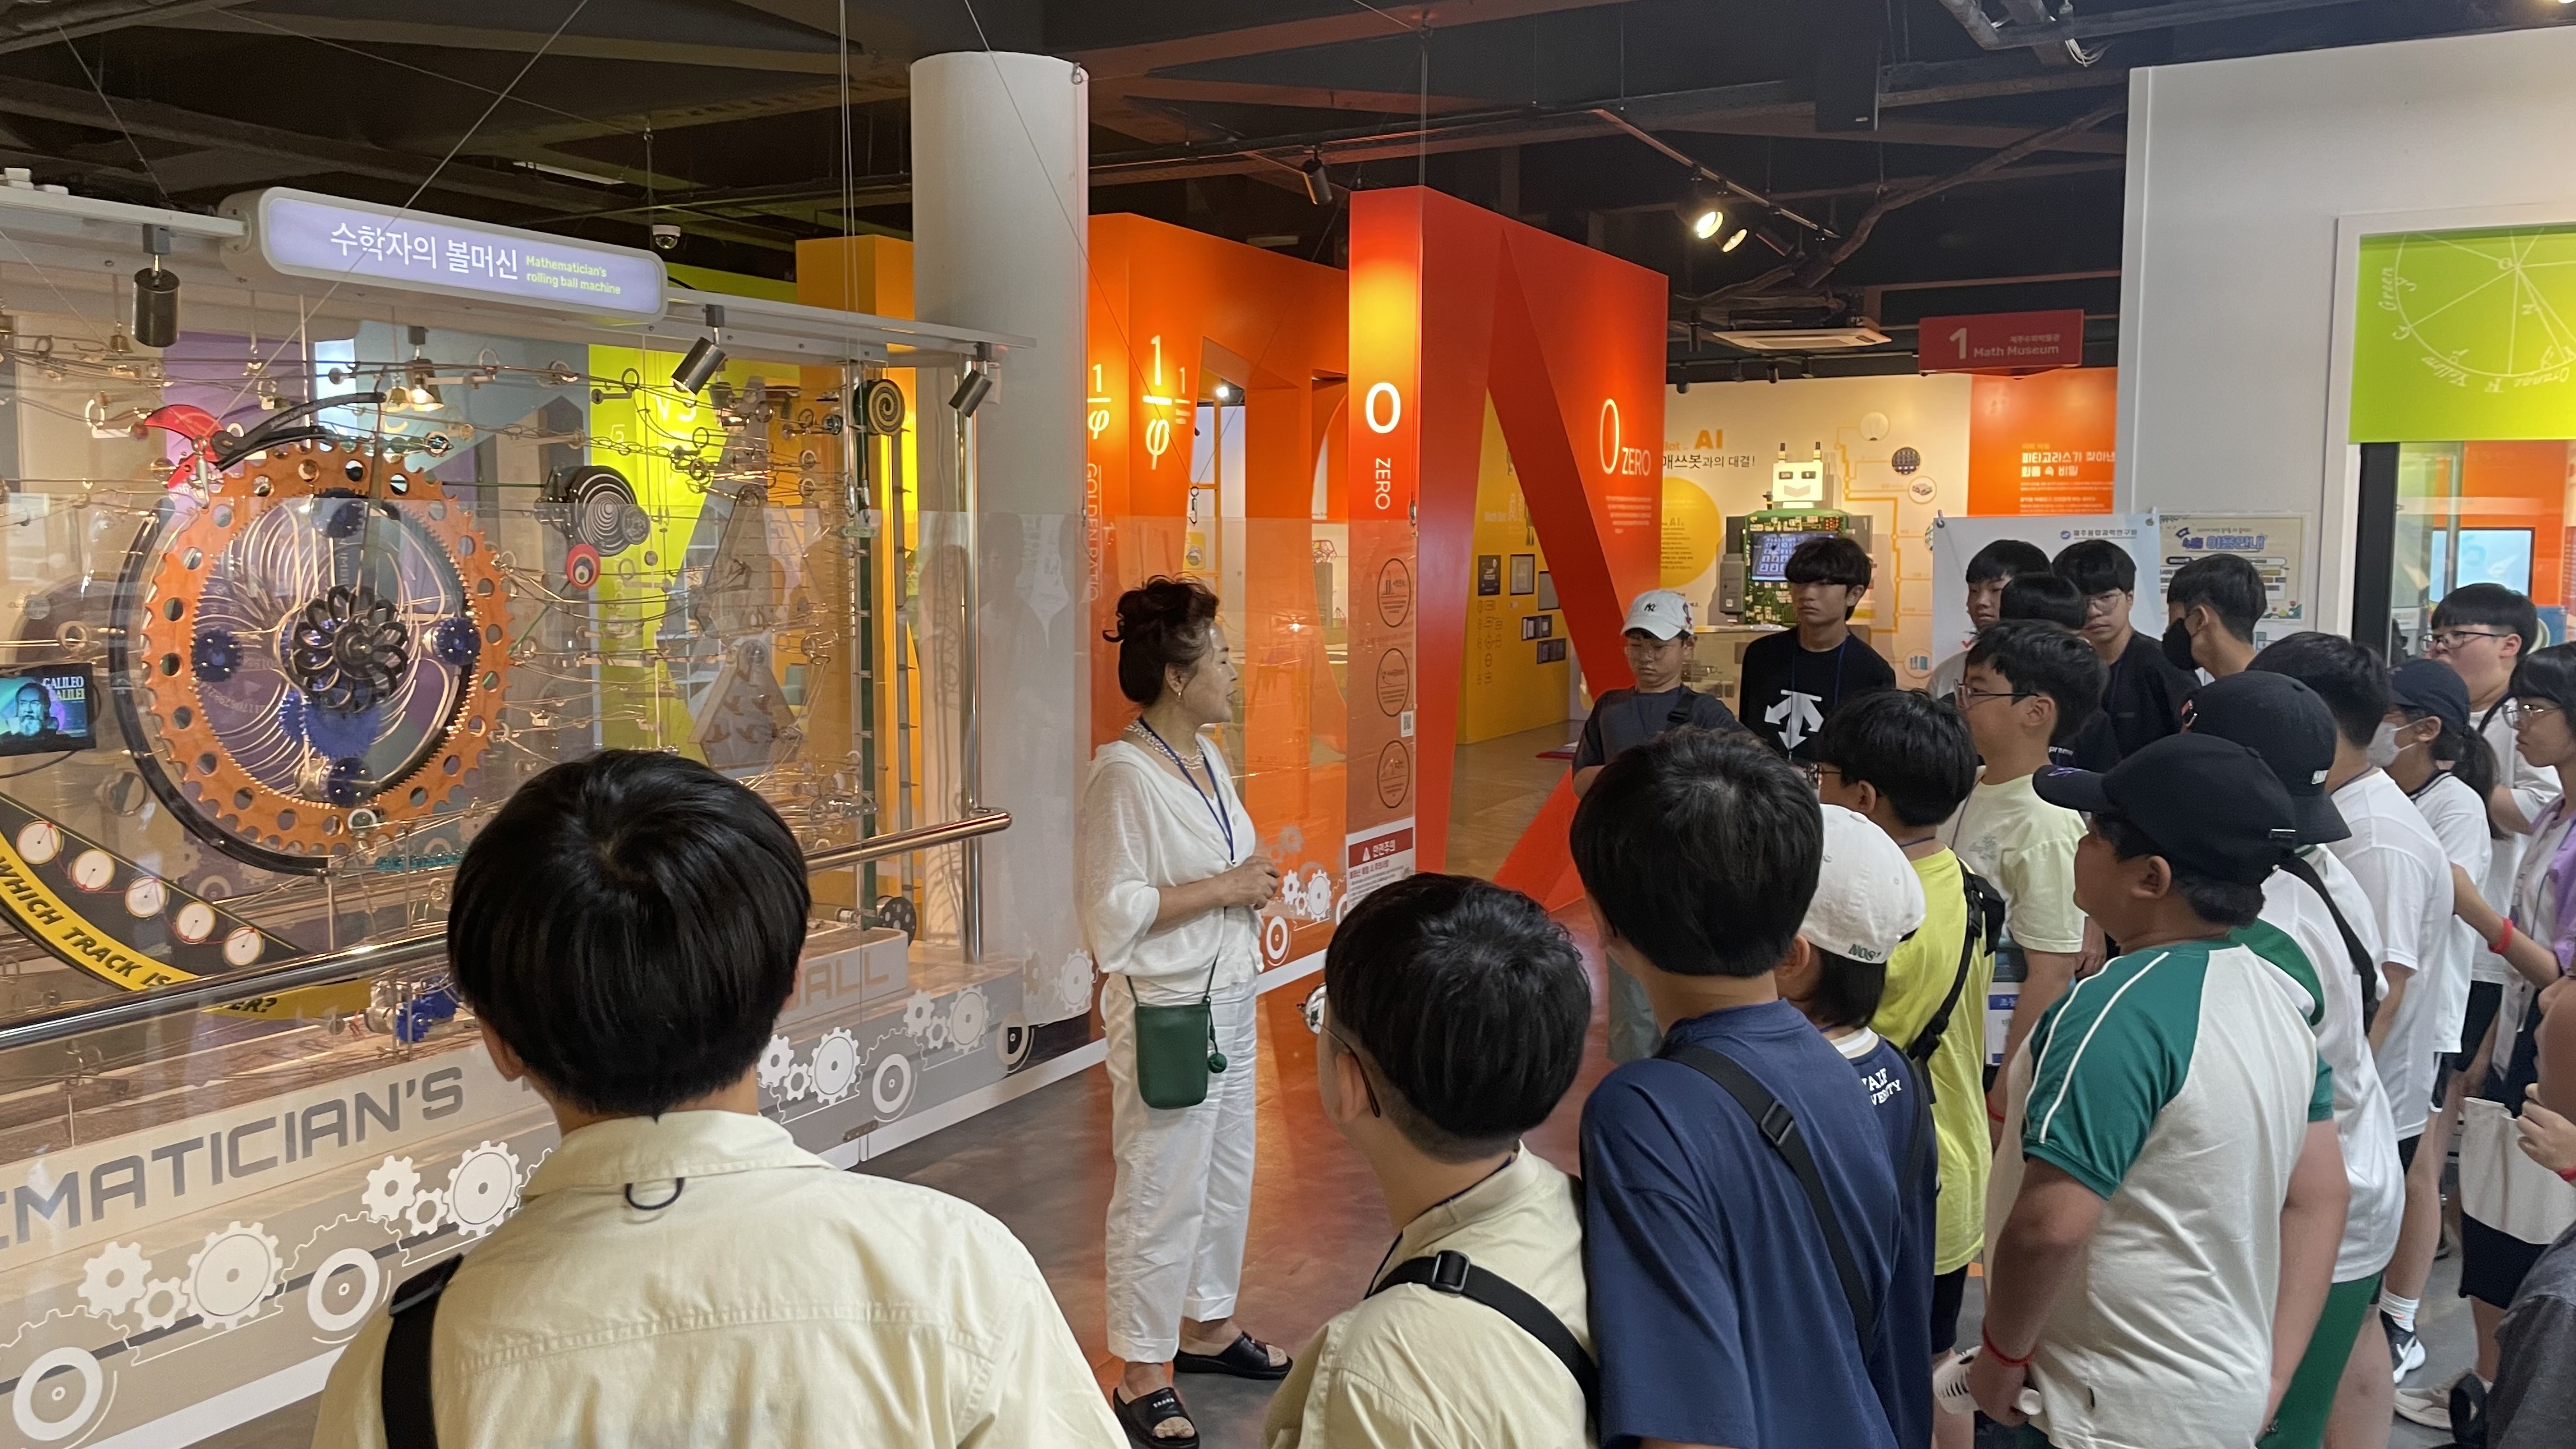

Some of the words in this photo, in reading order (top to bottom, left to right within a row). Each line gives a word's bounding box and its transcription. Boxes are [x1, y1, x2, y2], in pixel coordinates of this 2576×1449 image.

[330, 222, 437, 270] 수학자의
[445, 239, 519, 280] 볼머신
[526, 255, 607, 277] Mathematician's
[526, 272, 558, 288] rolling
[560, 275, 578, 288] ball
[580, 280, 622, 295] machine
[1949, 326, 1968, 360] 1
[1974, 347, 2005, 358] Math
[2007, 345, 2059, 356] Museum
[2421, 356, 2470, 388] Yellow
[1694, 429, 1723, 449] AI
[1622, 447, 1651, 476] ZERO
[1728, 456, 1756, 468] 대결!
[2058, 465, 2078, 477] 비밀
[1376, 457, 1391, 510] ZERO
[2206, 535, 2265, 550] 이용안내
[1089, 548, 1098, 601] RATIO
[42, 676, 84, 689] GALILEO
[55, 688, 86, 702] ALILEI
[0, 855, 65, 925] WHICH
[61, 926, 143, 979] TRACK
[792, 951, 889, 1008] ALL
